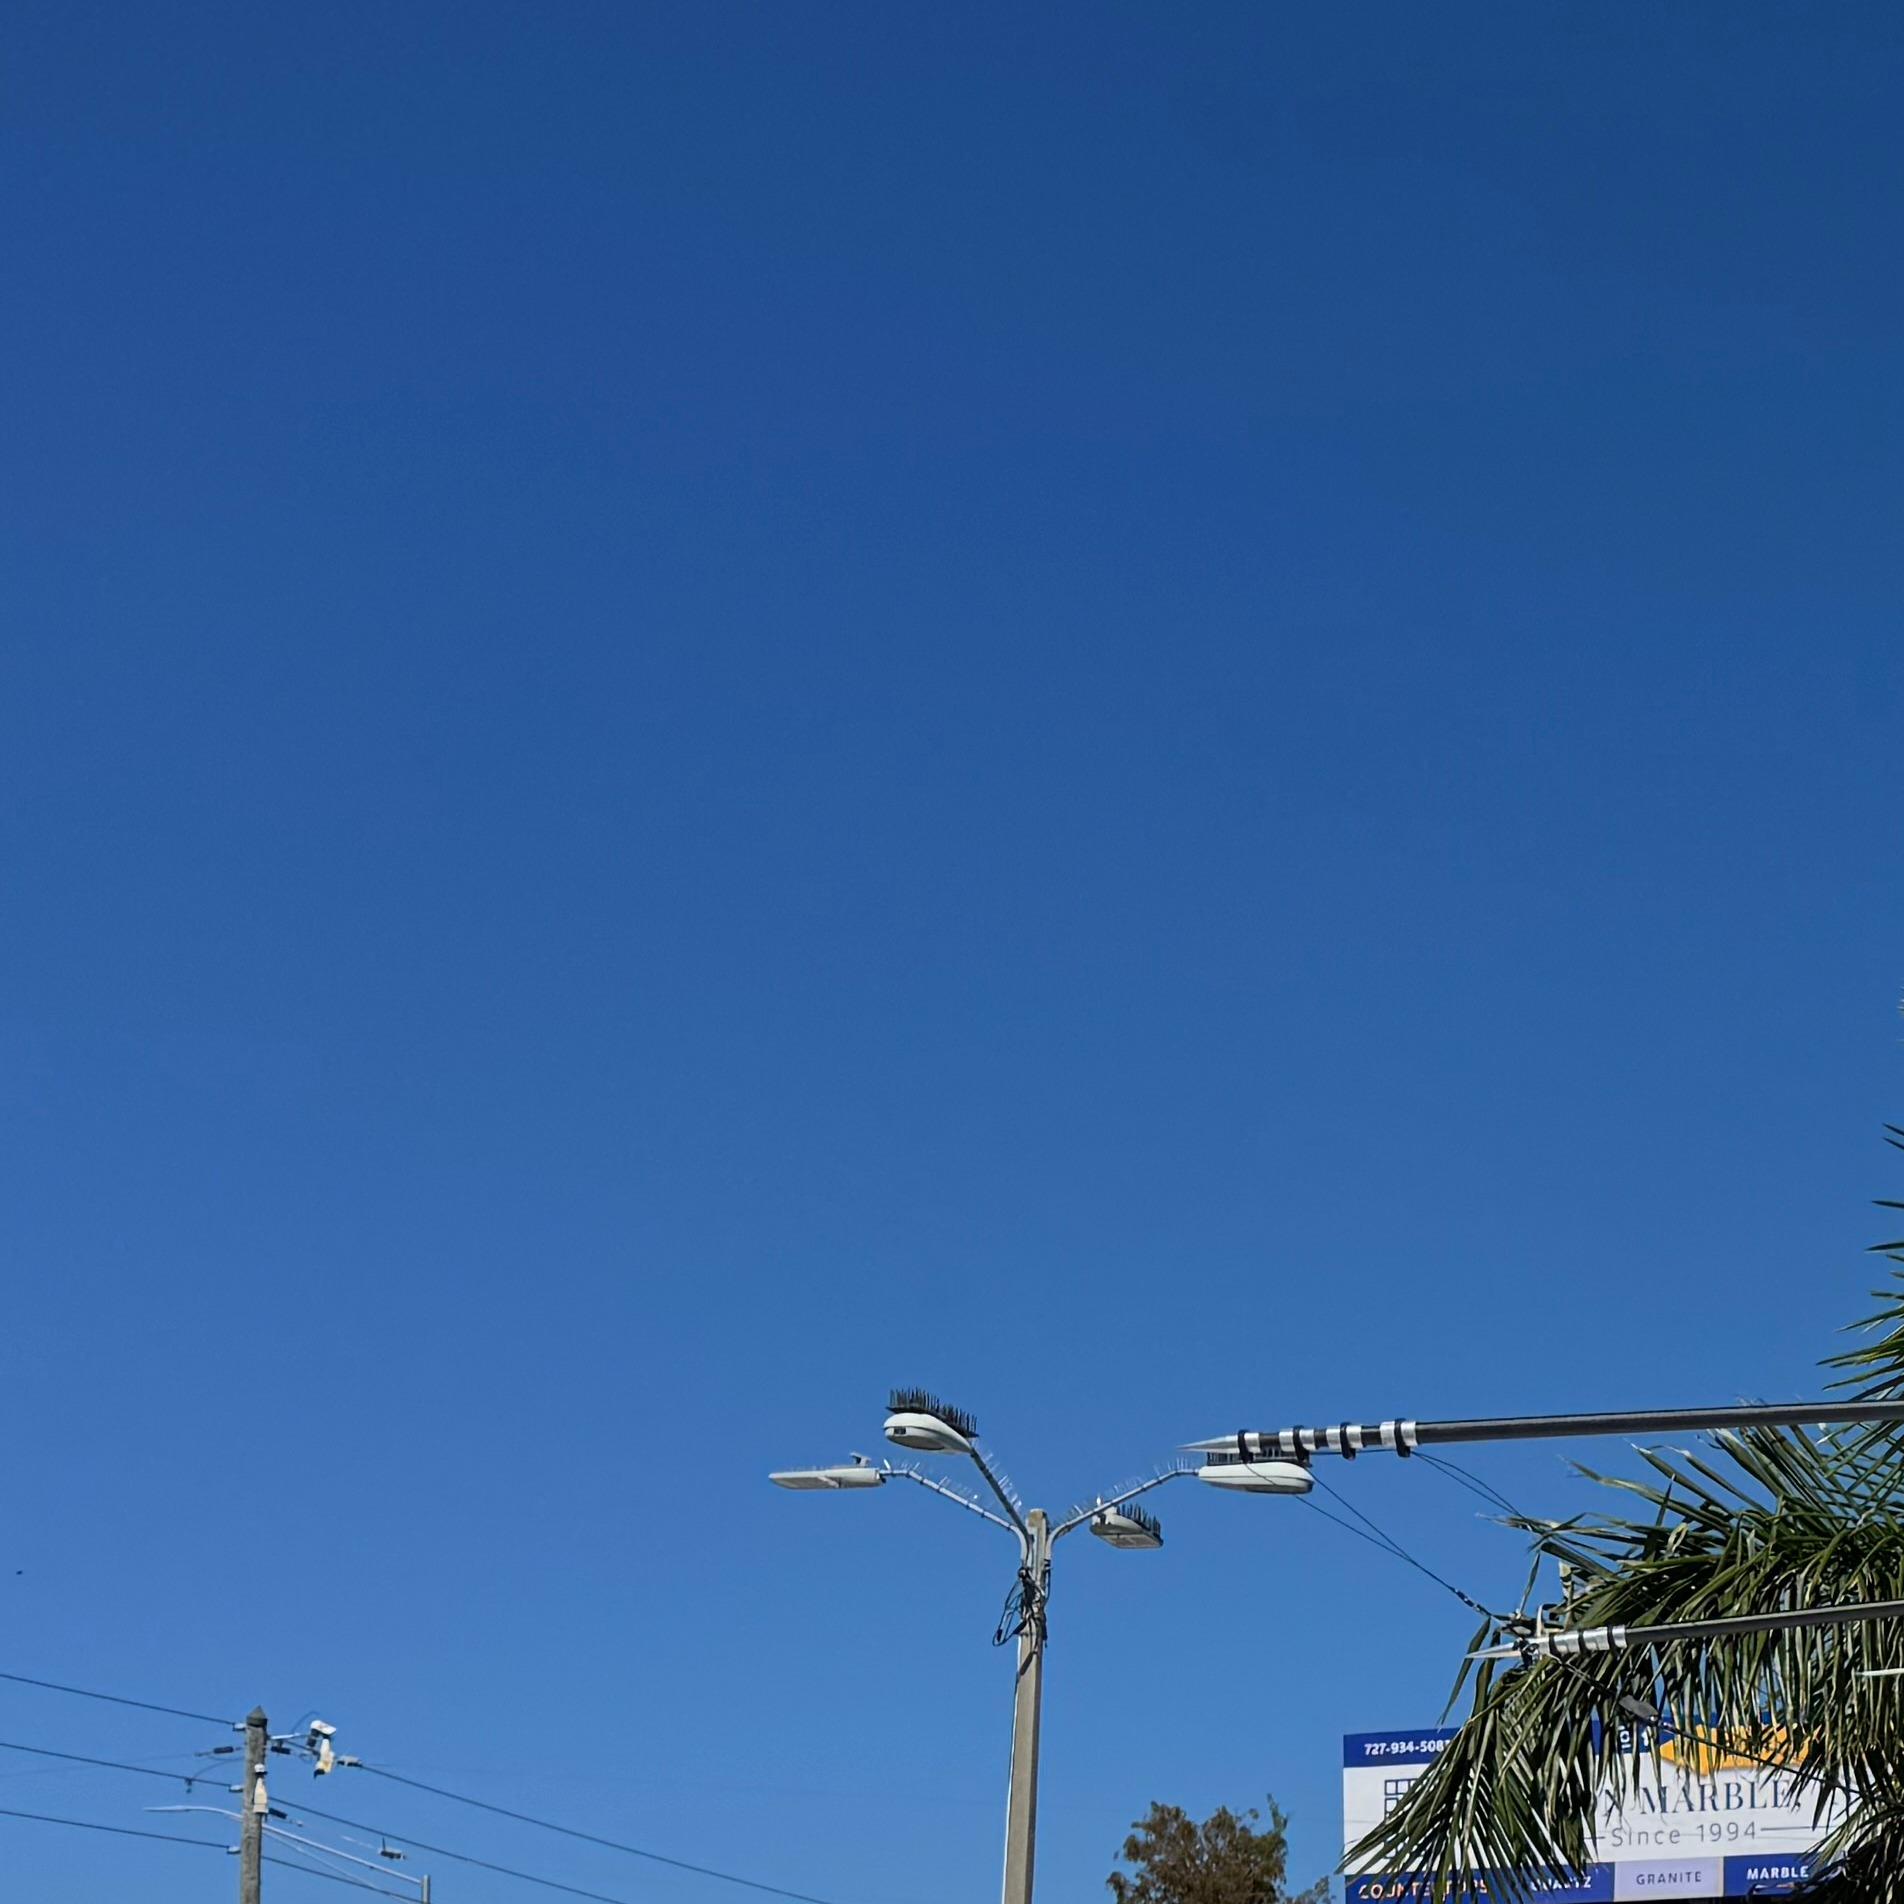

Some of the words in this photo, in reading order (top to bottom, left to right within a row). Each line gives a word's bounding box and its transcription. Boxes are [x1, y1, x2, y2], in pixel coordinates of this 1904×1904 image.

[1639, 1776, 1794, 1815] MARBLE
[1611, 1826, 1681, 1848] Since
[1696, 1821, 1756, 1843] 1994
[1635, 1871, 1703, 1886] GRANITE
[1746, 1864, 1810, 1881] MARBLE
